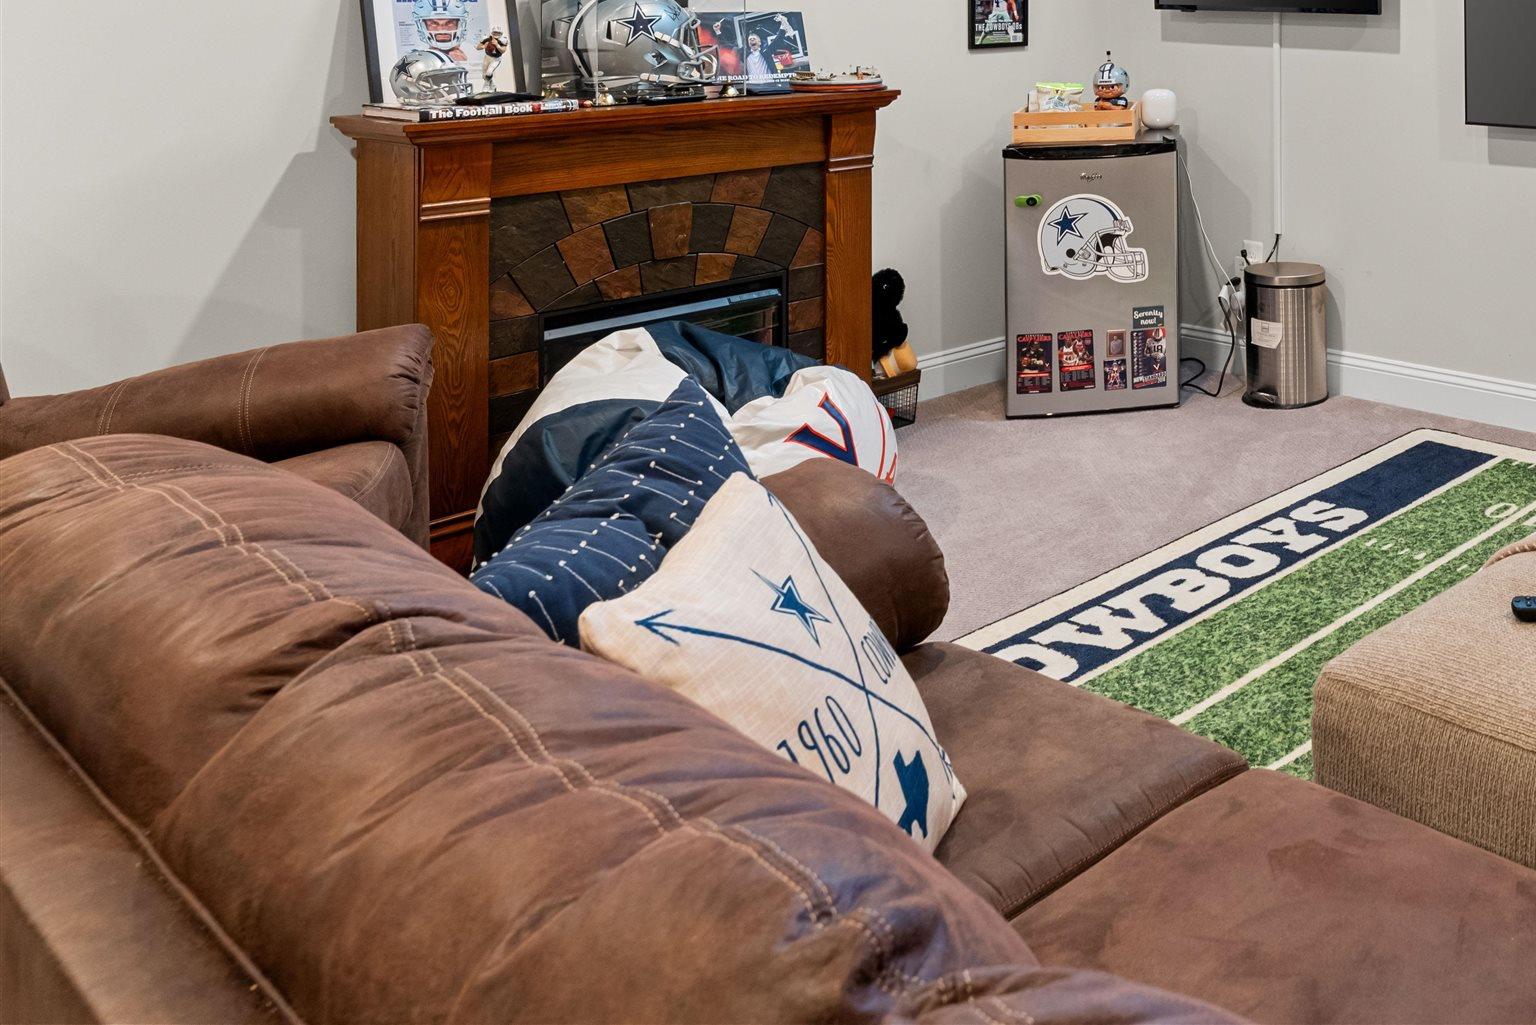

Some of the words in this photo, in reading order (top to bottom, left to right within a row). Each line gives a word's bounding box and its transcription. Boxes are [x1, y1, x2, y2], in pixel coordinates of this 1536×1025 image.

[430, 108, 453, 119] The
[455, 104, 503, 119] Football
[504, 103, 534, 114] Book
[1133, 309, 1163, 319] Serenity
[1140, 317, 1157, 325] now!
[991, 499, 1369, 681] OWBOYS
